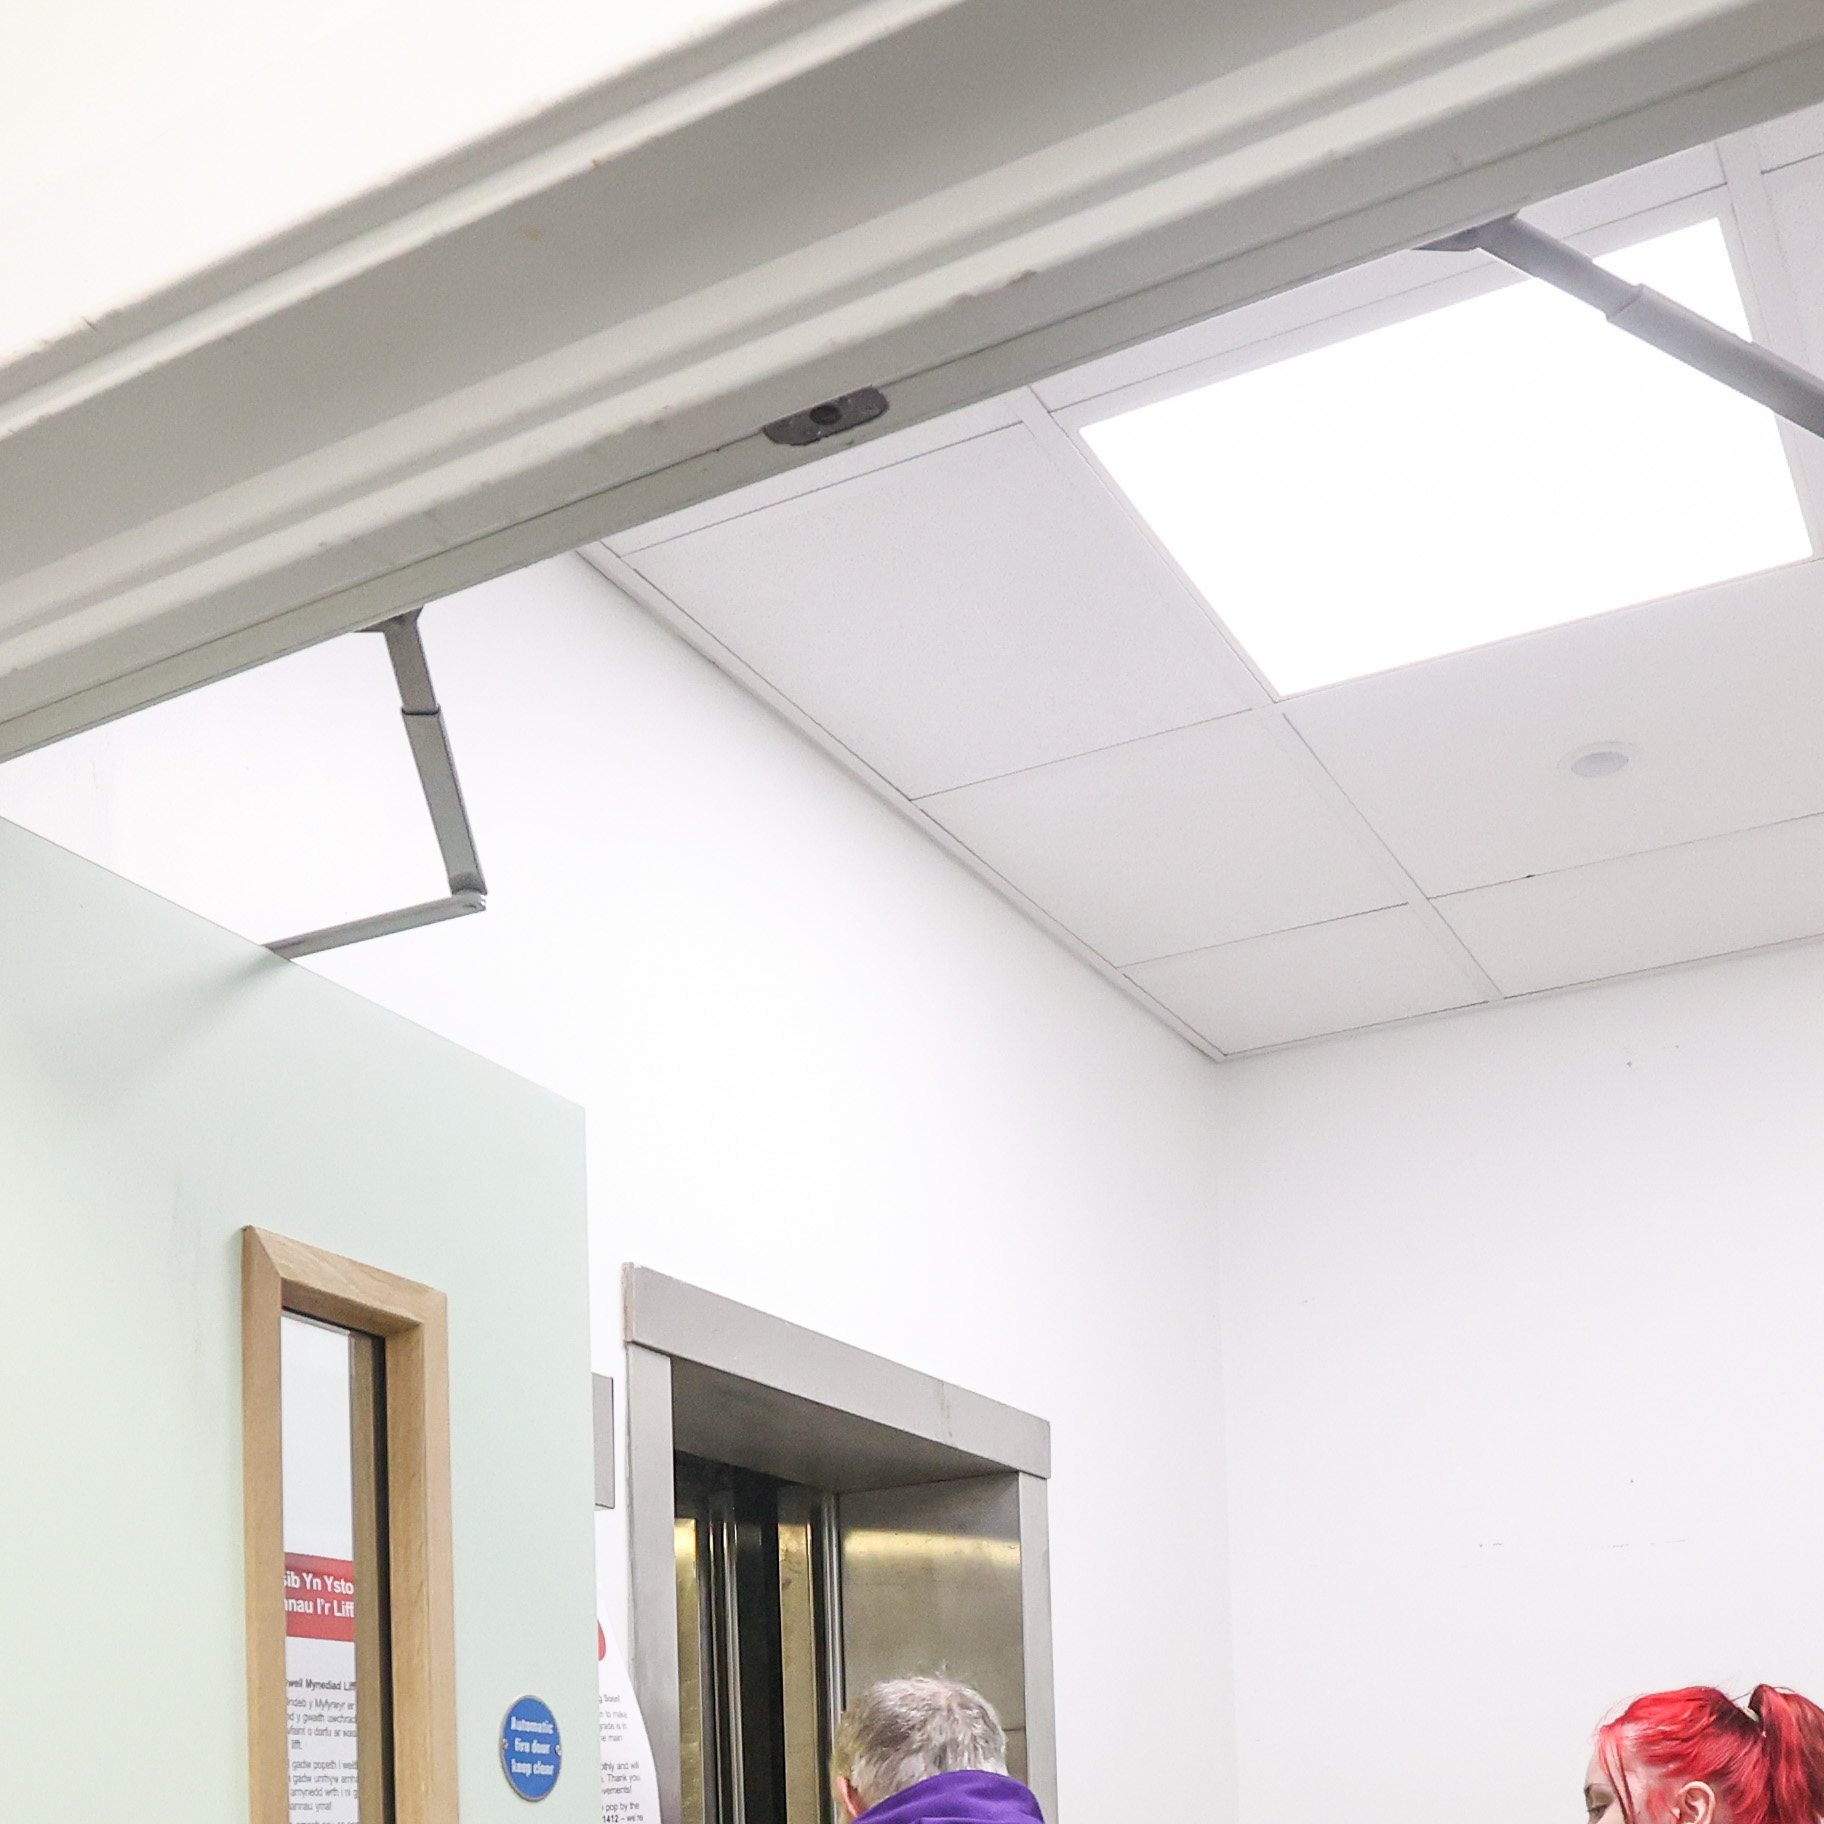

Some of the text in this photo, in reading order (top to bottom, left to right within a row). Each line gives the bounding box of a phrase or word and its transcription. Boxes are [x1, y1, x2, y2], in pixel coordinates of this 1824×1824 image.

[302, 1572, 322, 1591] Yn
[305, 1678, 342, 1691] Mynediad
[510, 1715, 554, 1735] Automatic
[514, 1736, 551, 1755] fire door
[511, 1758, 555, 1778] keep clear
